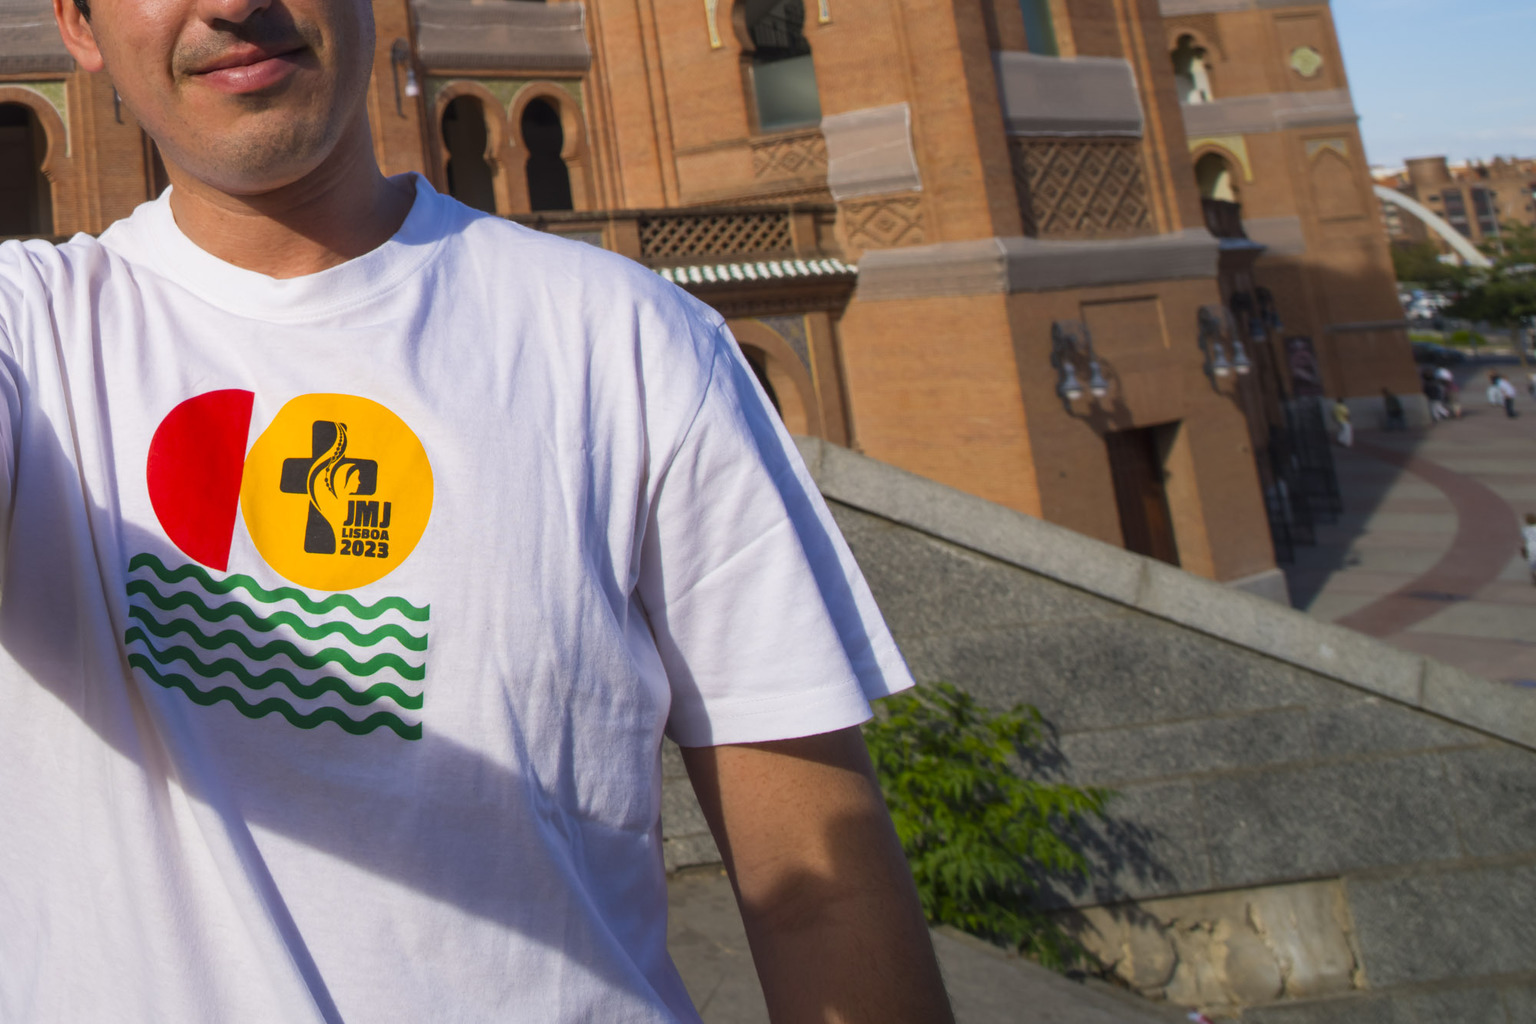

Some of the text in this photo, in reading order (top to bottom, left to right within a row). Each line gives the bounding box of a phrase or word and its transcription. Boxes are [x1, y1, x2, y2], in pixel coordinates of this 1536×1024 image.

[343, 500, 392, 528] JMJ
[341, 528, 390, 541] LISBOA
[340, 539, 389, 559] 2023
